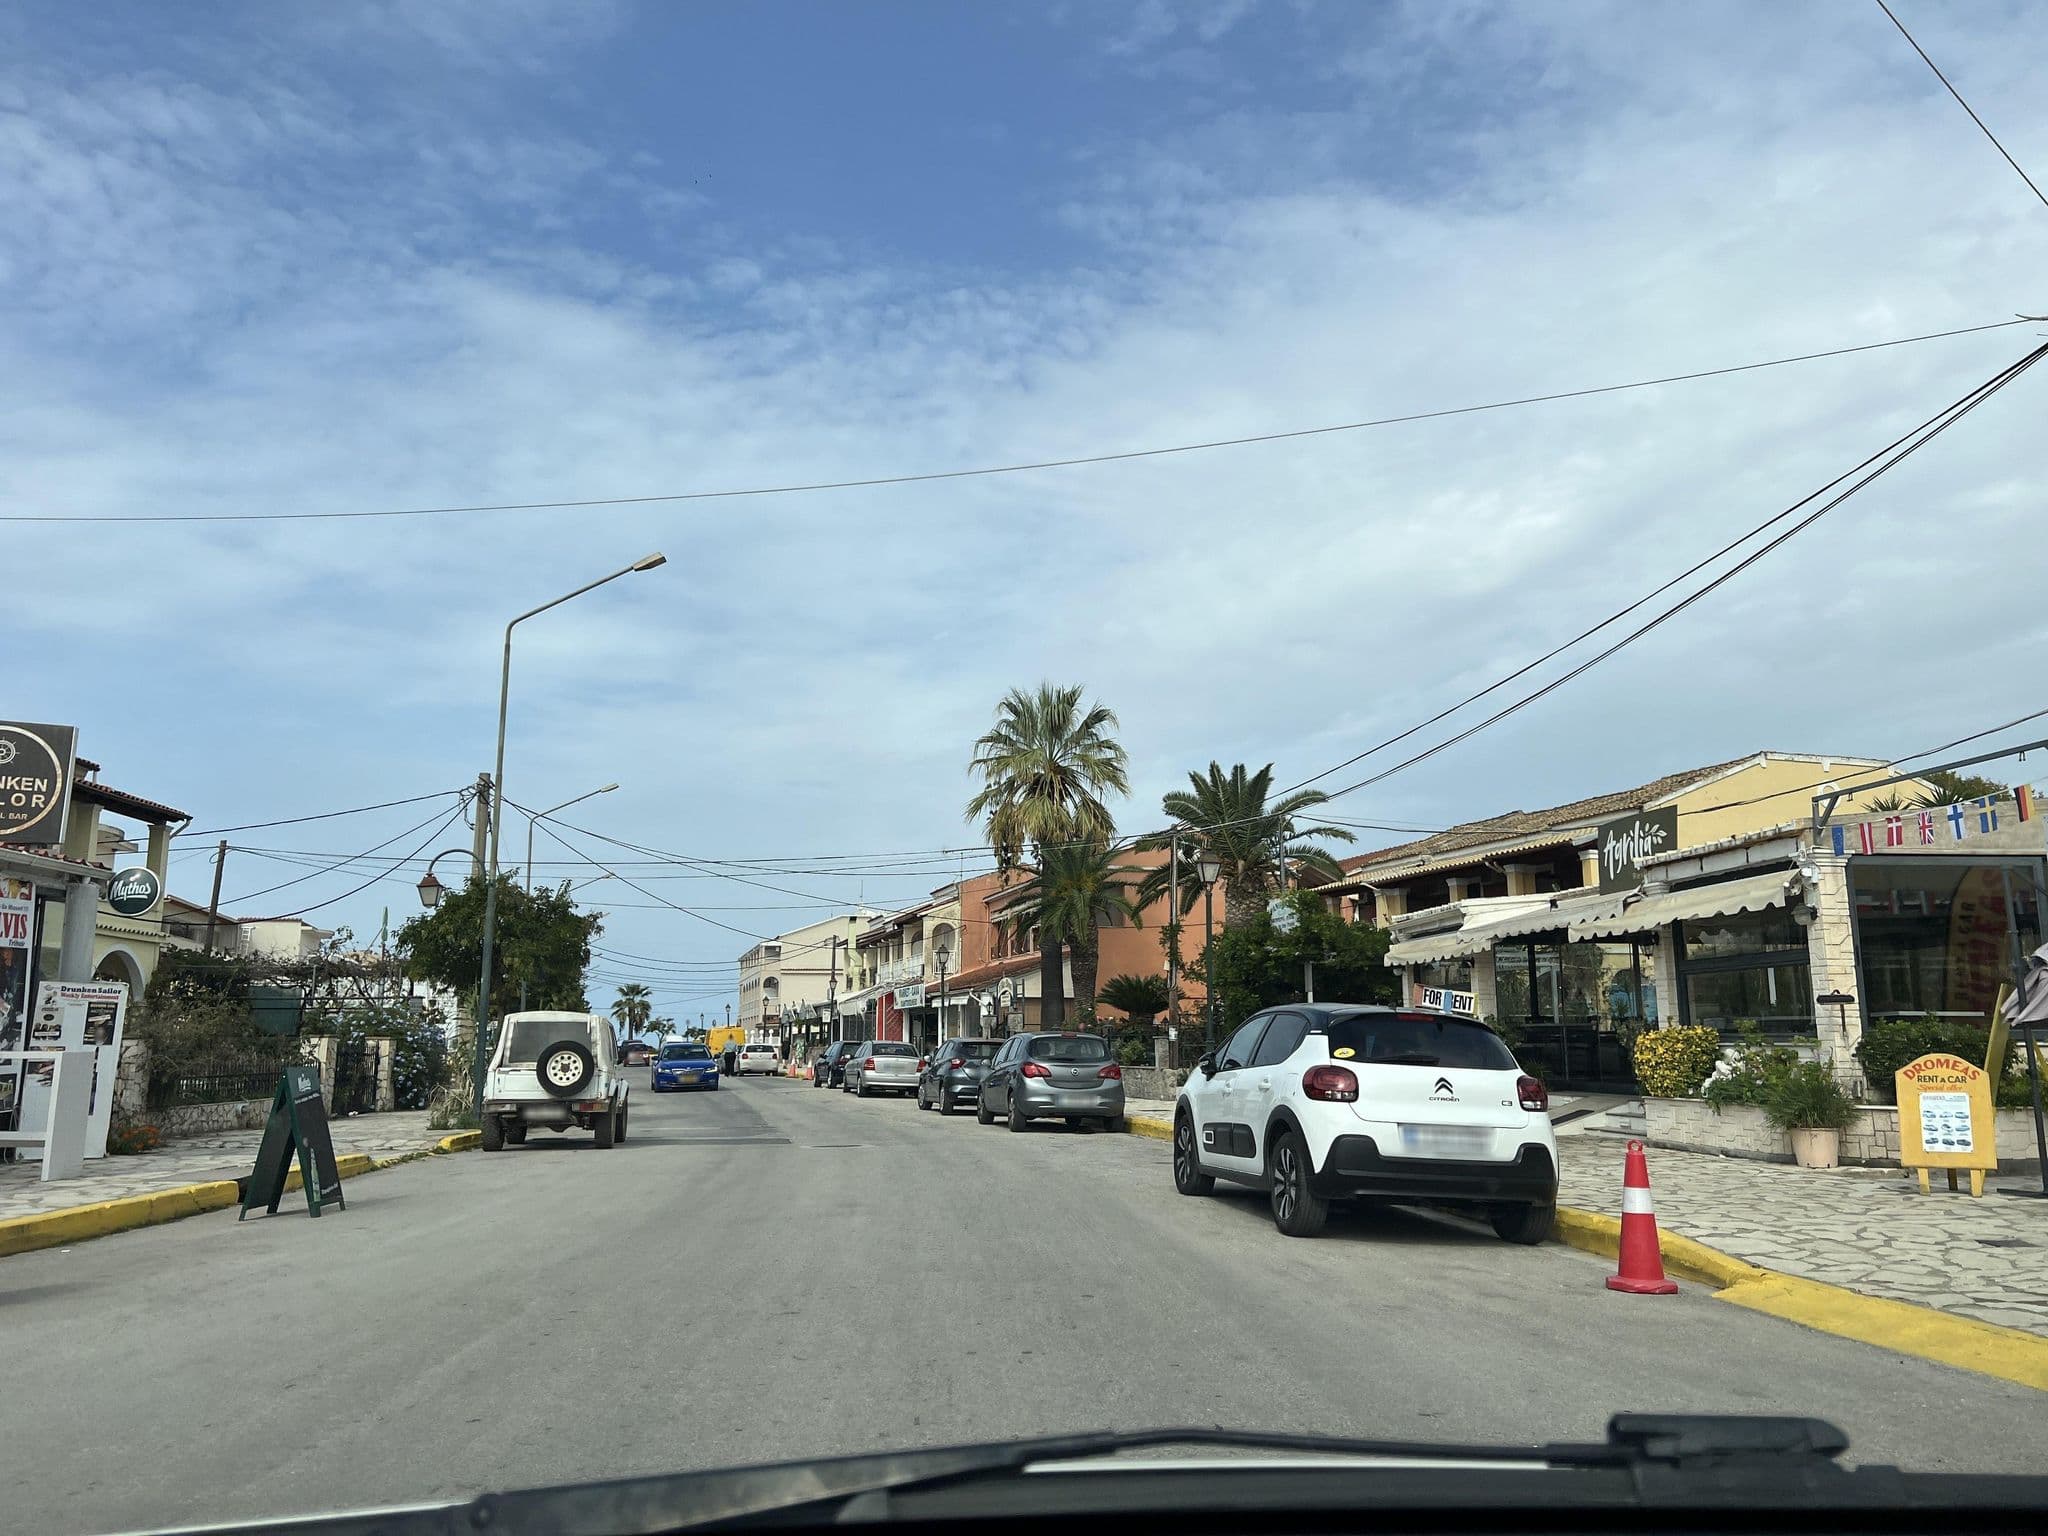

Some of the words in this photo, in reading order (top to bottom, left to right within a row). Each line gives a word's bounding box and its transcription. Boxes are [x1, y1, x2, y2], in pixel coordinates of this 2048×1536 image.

[8, 812, 28, 820] BAR
[1603, 820, 1652, 881] Agrilia
[110, 880, 151, 901] Mythos
[60, 985, 97, 994] Drunken
[98, 986, 122, 994] Sailor
[60, 992, 80, 1000] Weekly
[1423, 988, 1443, 1007] FOR
[1451, 994, 1475, 1012] ENT
[1903, 1059, 1980, 1080] DROMEAS
[1917, 1075, 1938, 1083] RENT
[1947, 1075, 1967, 1083] CAR
